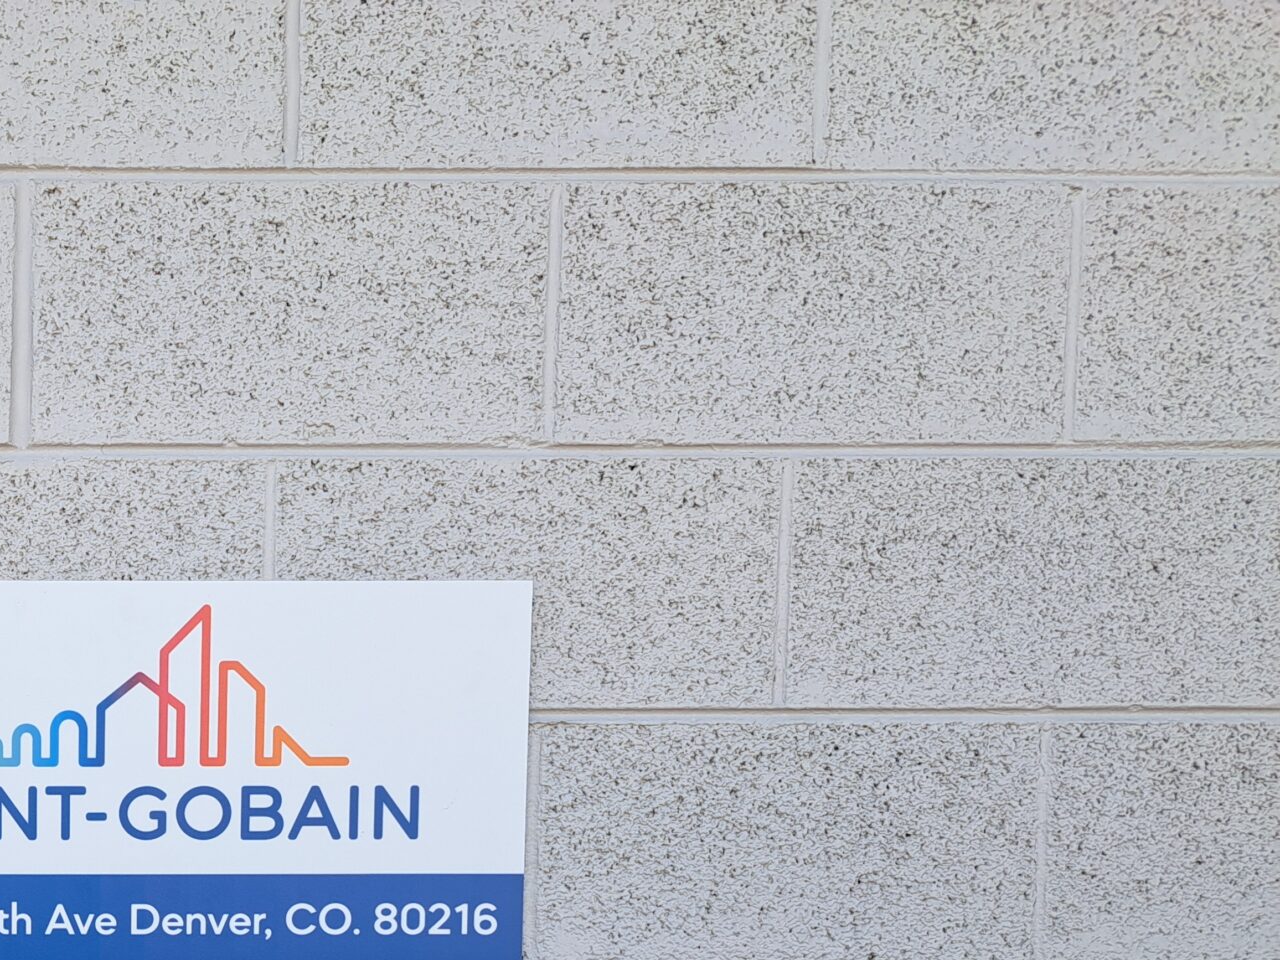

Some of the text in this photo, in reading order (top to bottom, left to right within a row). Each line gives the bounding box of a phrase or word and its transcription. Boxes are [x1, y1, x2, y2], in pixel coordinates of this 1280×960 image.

[46, 904, 116, 935] Ave
[131, 904, 271, 939] Denver,
[286, 903, 359, 935] CO.
[374, 903, 497, 935] 80216
